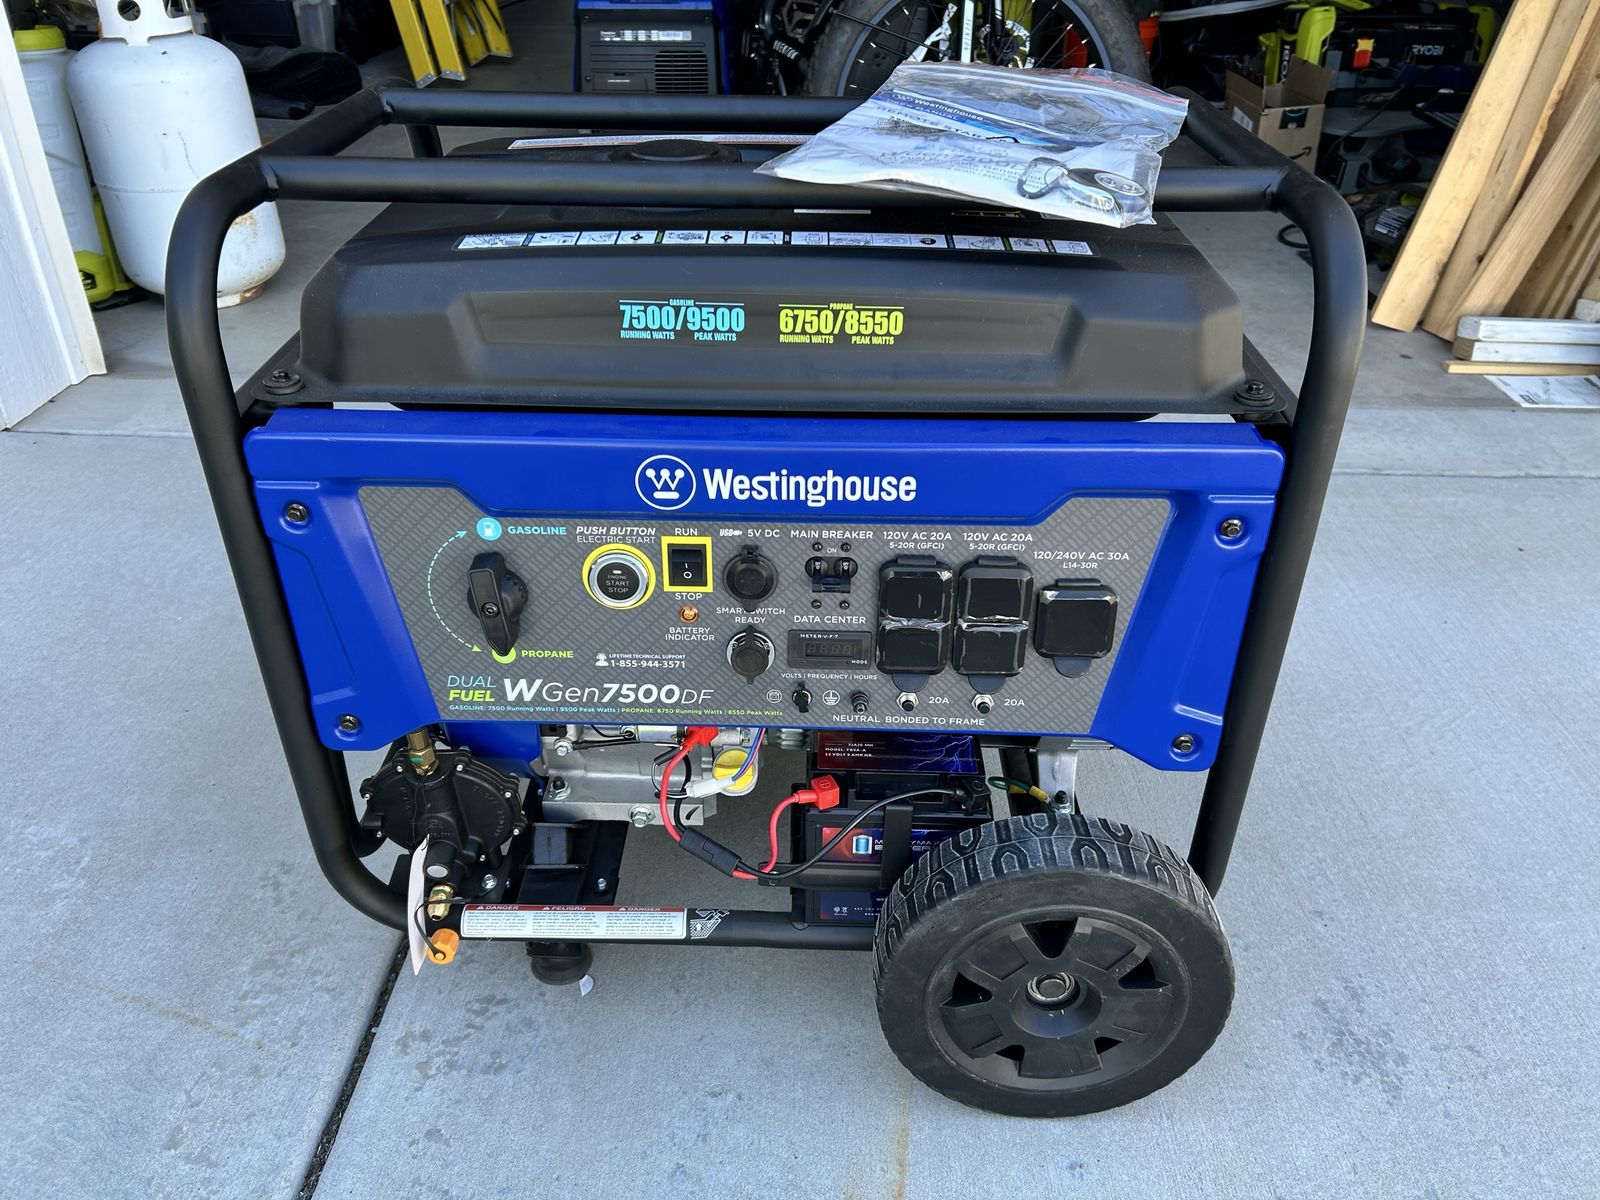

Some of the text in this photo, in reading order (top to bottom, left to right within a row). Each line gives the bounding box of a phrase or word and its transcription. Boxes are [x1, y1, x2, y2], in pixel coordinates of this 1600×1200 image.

[1411, 45, 1445, 55] RYOBI
[1281, 45, 1291, 84] YOBI
[914, 99, 983, 121] Westinghouse
[619, 304, 745, 332] 7500/9500
[779, 308, 904, 336] 6750/8550
[620, 330, 675, 340] RUNNING WATTS
[694, 332, 737, 341] PEAK WATTS
[780, 334, 834, 344] RUNNING WATTS
[851, 335, 894, 345] PEAK WATTS
[702, 468, 917, 507] Westinghouse
[508, 526, 567, 535] GASOLINE
[576, 526, 656, 536] PUSH BUTTON
[674, 527, 698, 536] RUN
[747, 529, 762, 537] 5V
[764, 529, 780, 538] DC
[790, 530, 873, 540] MAIN BREAKER
[576, 535, 656, 544] ELECTRIC START
[883, 532, 952, 541] 120V AC 20A
[963, 533, 1033, 542] 120V AC 20A
[889, 541, 945, 550] 5-20R (GFCI)
[969, 543, 1025, 552] 5-20R (GFCI)
[1034, 551, 1130, 561] 120/240V AC 30A
[1063, 561, 1098, 569] L14-30R
[674, 592, 703, 601] STOP
[735, 617, 766, 625] READY
[794, 615, 866, 625] DATA CENTER
[669, 627, 710, 635] BATTERY
[665, 634, 715, 642] INDICATOR
[521, 650, 574, 659] PROPANE
[610, 659, 686, 669] 1-855-944-3571
[447, 675, 497, 688] DUAL
[807, 673, 849, 681] FREQUENCY
[448, 689, 496, 702] FUEL
[928, 696, 950, 704] 20A
[1004, 698, 1025, 706] 20A
[833, 714, 985, 726] NEUTRAL BONDED TO FRAME
